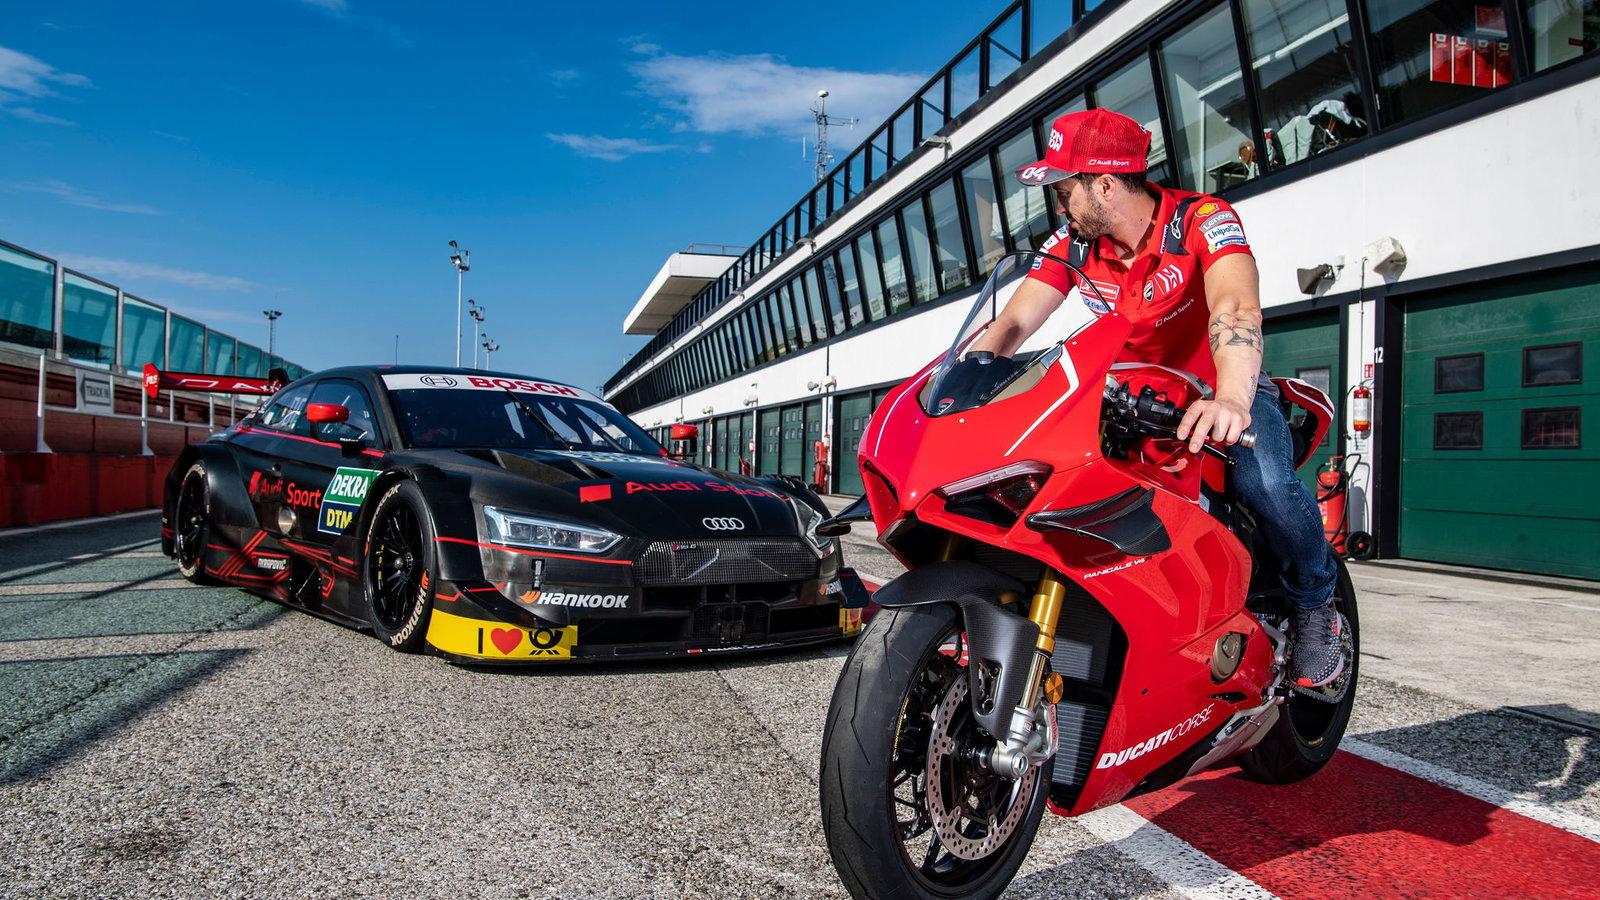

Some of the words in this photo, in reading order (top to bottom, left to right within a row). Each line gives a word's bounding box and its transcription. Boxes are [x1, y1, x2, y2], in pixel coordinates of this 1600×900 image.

[1021, 166, 1048, 181] 04
[1203, 212, 1233, 231] Lenovo
[1163, 311, 1178, 323] Audi
[1178, 298, 1195, 314] Sport
[1374, 347, 1384, 363] 12
[467, 376, 580, 398] BOSCH
[259, 478, 285, 497] Audi
[286, 482, 322, 509] Sport
[330, 473, 370, 499] DEKRA
[626, 480, 702, 494] Audi
[703, 480, 791, 502] Sport
[326, 508, 353, 529] DTM
